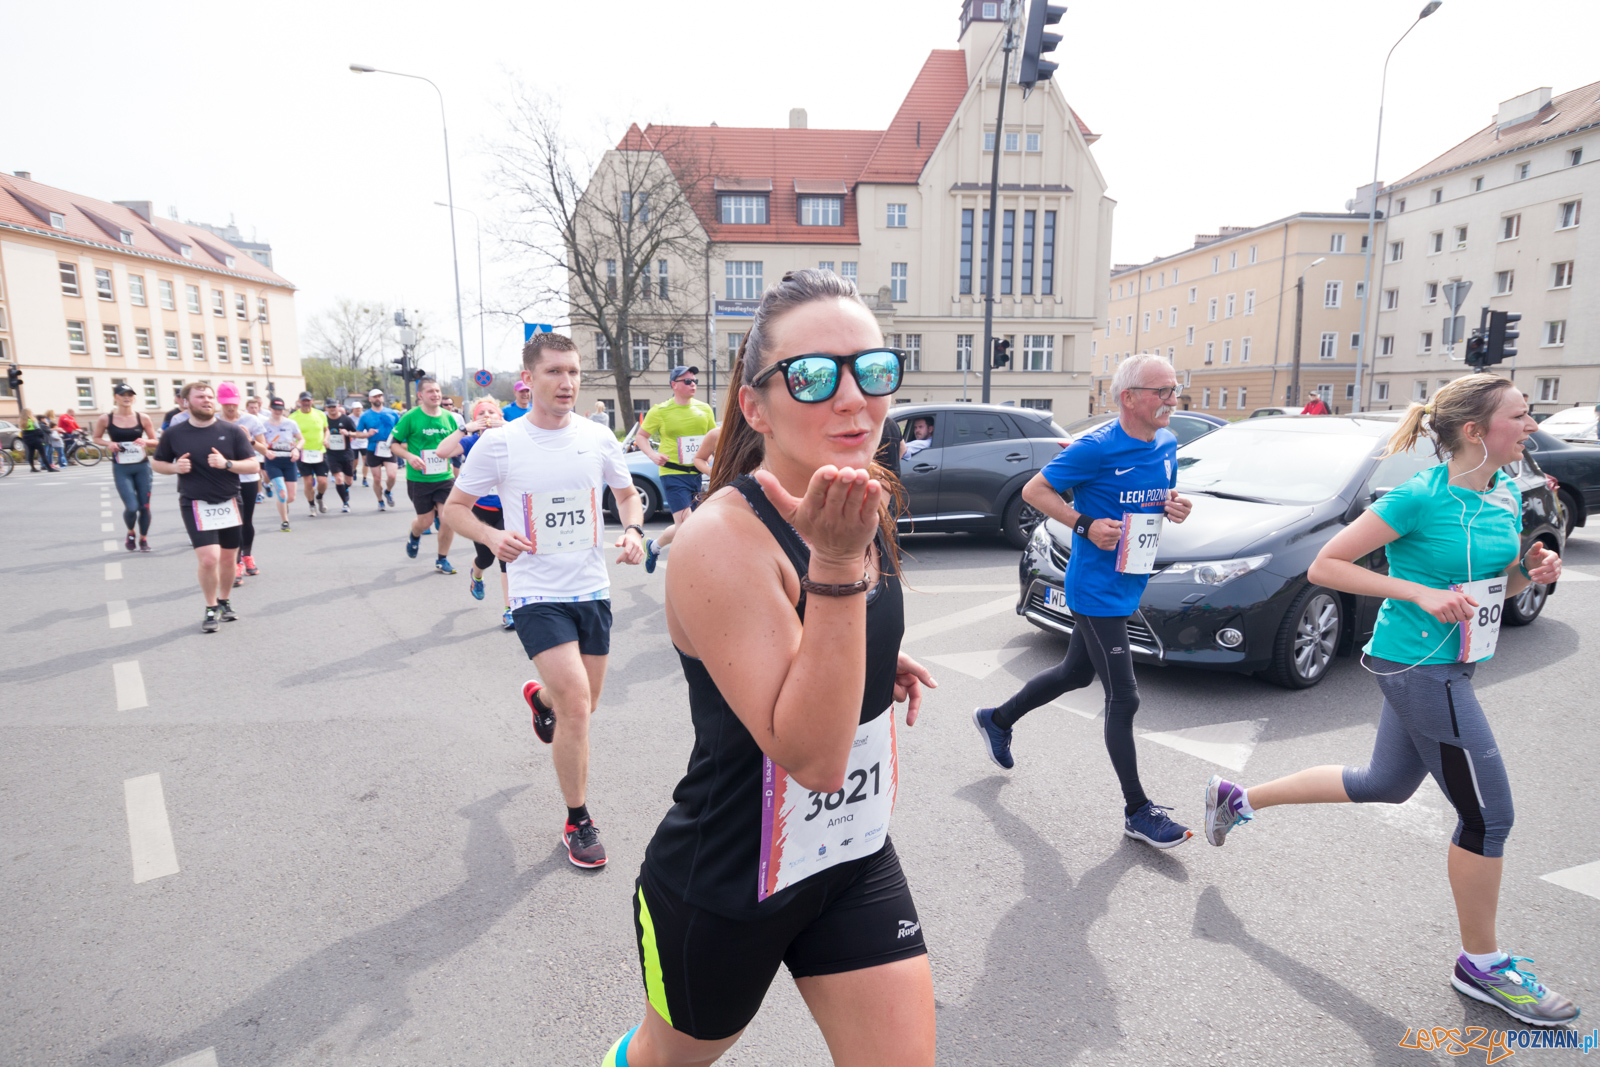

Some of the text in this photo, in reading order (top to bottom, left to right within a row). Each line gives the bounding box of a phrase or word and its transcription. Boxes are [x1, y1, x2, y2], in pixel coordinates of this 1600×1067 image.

[686, 444, 701, 453] 302
[1119, 488, 1169, 504] LECH POZNA
[204, 507, 231, 517] 3709
[545, 509, 586, 528] 8713
[827, 814, 854, 828] Anna
